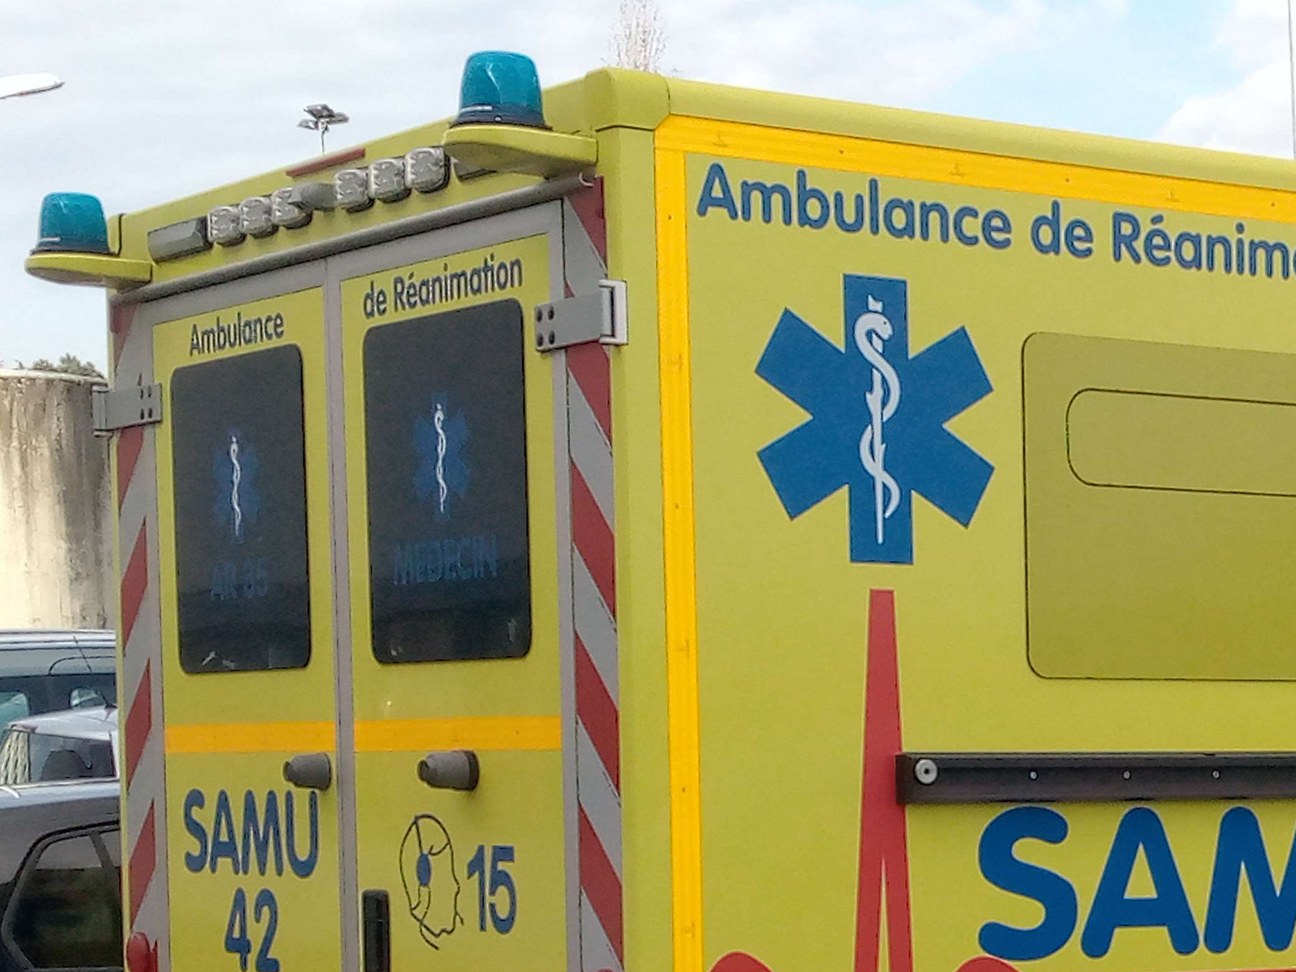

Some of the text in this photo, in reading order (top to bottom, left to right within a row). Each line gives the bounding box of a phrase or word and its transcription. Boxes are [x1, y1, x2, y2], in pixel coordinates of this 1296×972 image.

[697, 162, 1013, 250] Ambulance
[1031, 199, 1094, 258] de
[362, 253, 524, 319] de Réanimation
[189, 310, 284, 357] Ambulance
[182, 788, 319, 878] SAMU
[466, 844, 517, 935] 15
